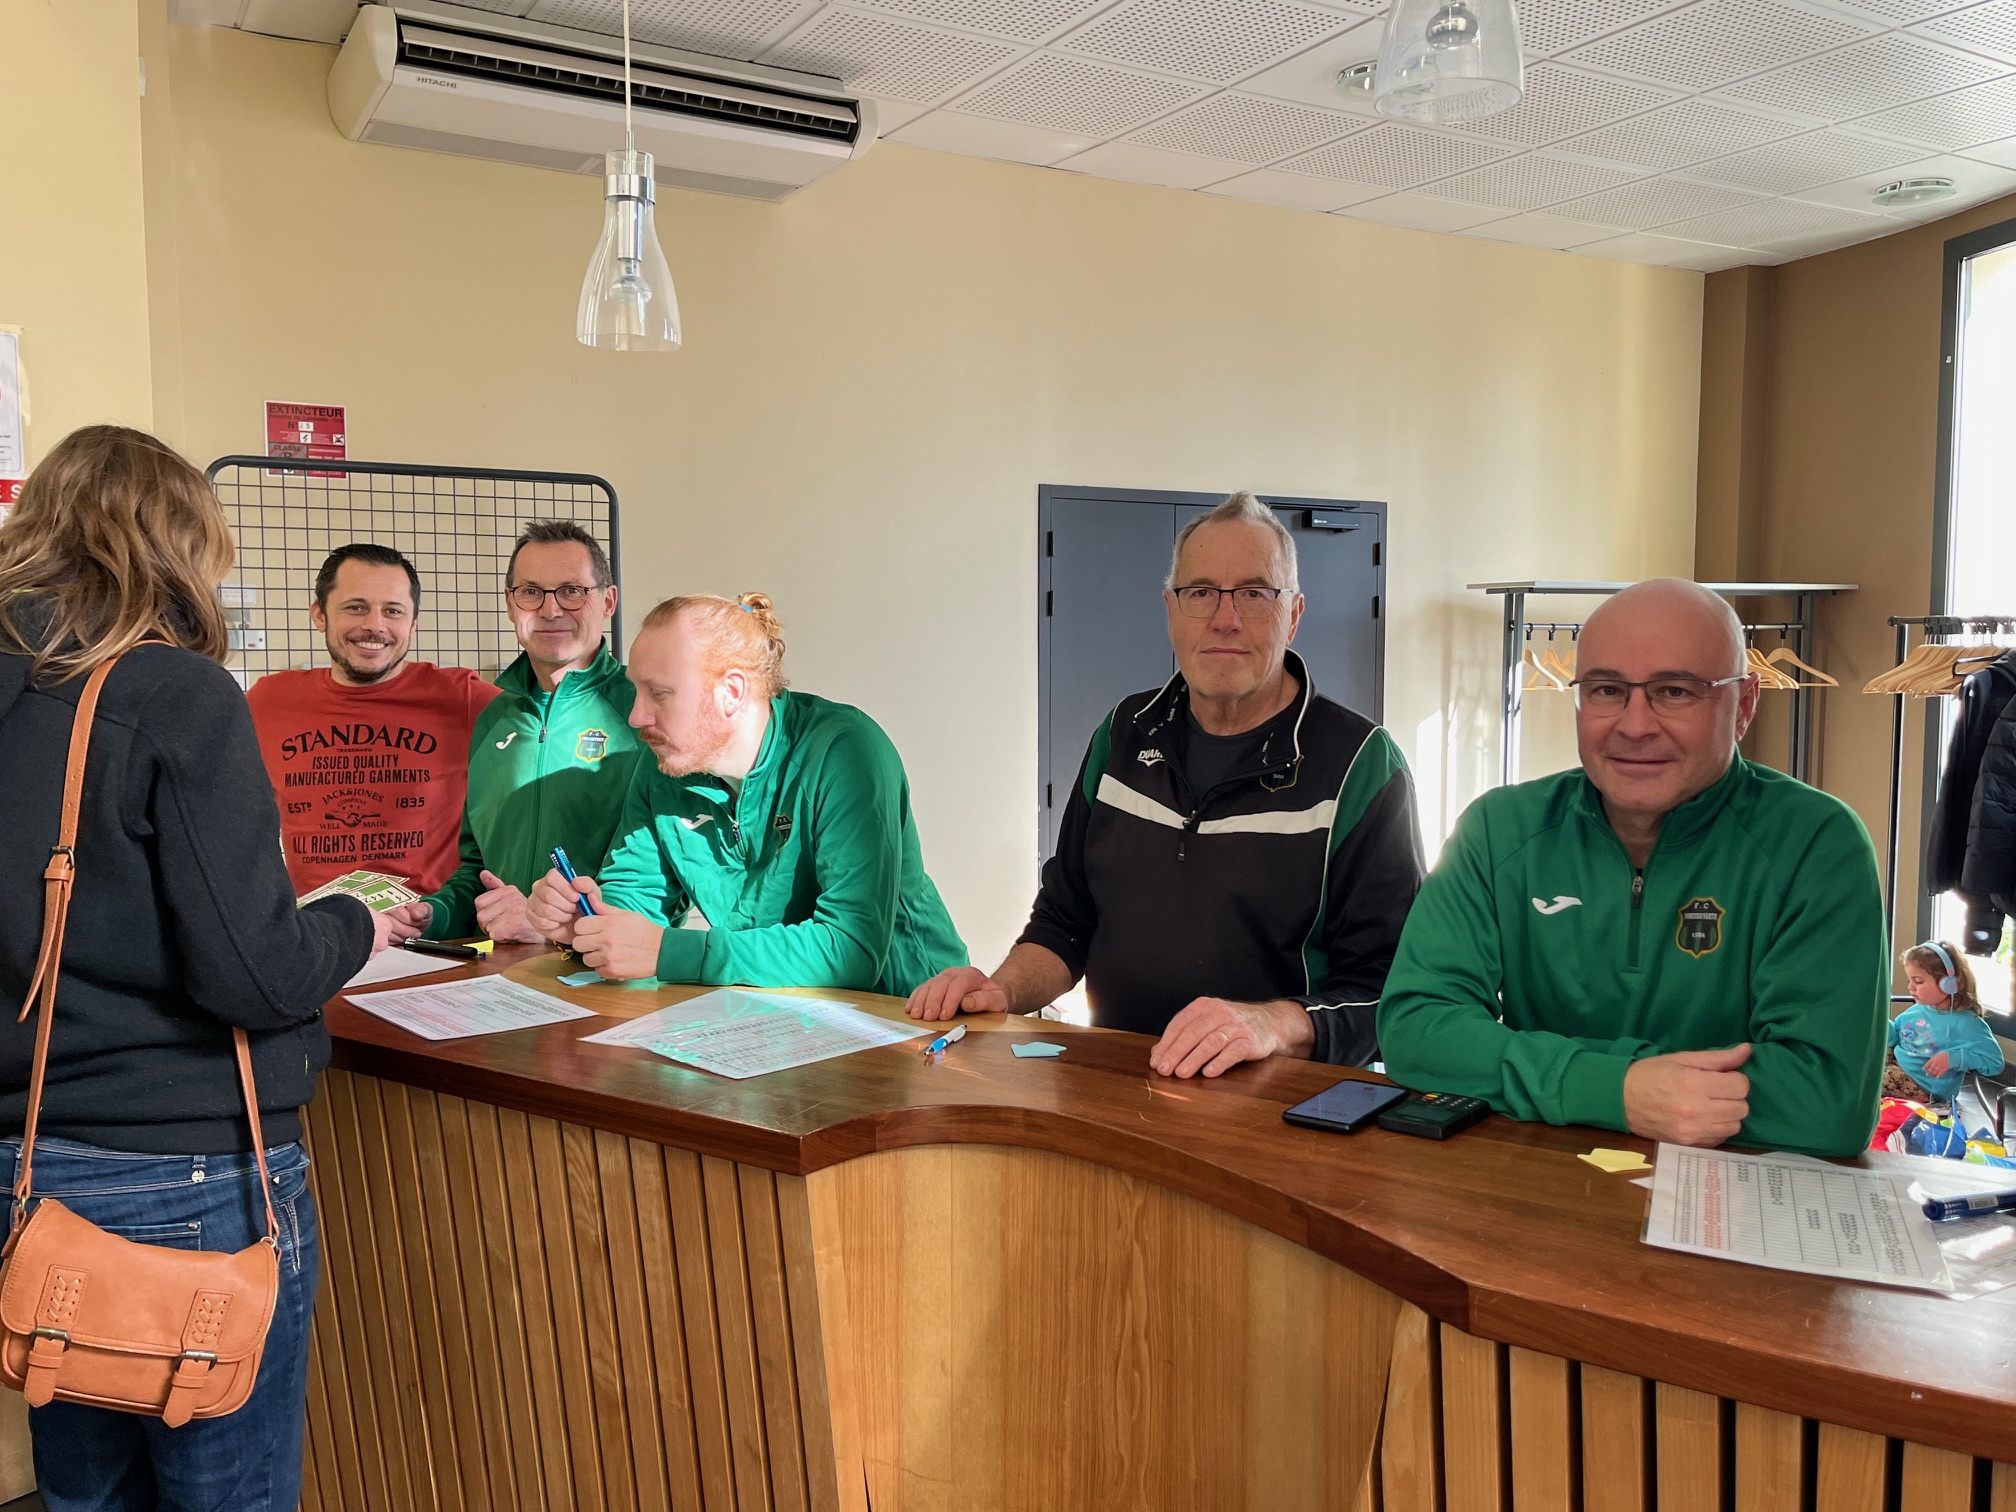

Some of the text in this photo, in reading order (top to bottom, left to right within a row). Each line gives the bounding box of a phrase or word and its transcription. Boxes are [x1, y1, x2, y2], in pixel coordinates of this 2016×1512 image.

[417, 76, 457, 89] HITACHI
[269, 404, 342, 417] EXTINCTEUR
[273, 444, 301, 452] CLASSE
[281, 723, 437, 761] STANDARD
[312, 754, 399, 773] ISSUED QUALITY
[284, 769, 431, 787] MANUFACTURED GARMENTS
[337, 798, 367, 807] COMPANY
[395, 797, 425, 809] 1835
[362, 820, 388, 828] MADE
[292, 831, 424, 854] ALL RIGHTS RESERVED
[302, 851, 407, 864] COPENHAGEN DENMARK
